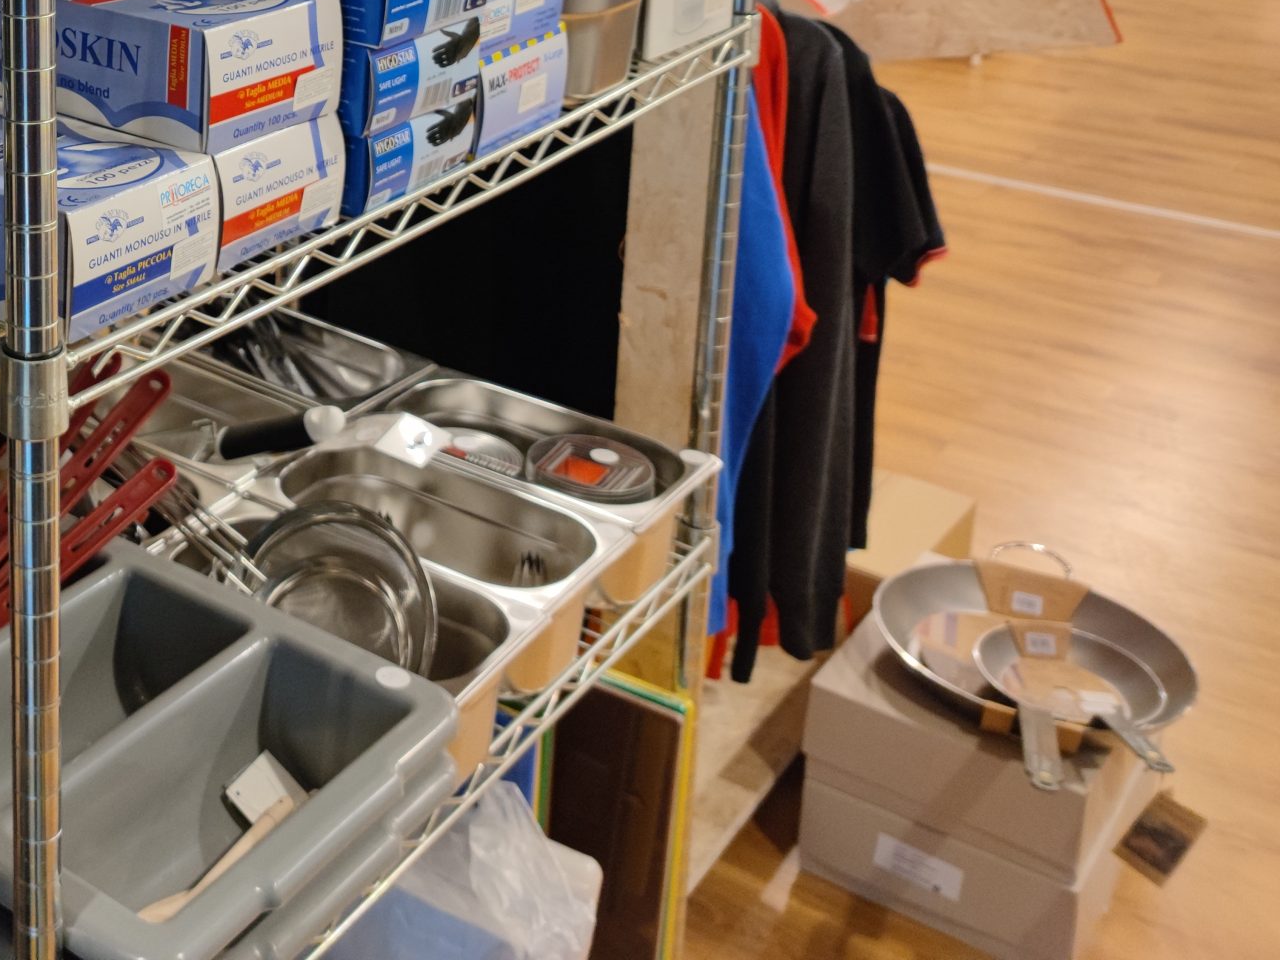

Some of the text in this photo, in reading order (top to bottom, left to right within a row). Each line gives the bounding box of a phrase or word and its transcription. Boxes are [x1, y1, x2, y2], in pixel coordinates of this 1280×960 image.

[223, 68, 253, 83] GUANTI
[256, 53, 297, 72] MONOUSO
[300, 49, 308, 59] IN
[378, 50, 415, 72] HYGOSTAR
[379, 80, 391, 91] SAFE
[489, 57, 541, 92] MAX-PROTECT
[61, 77, 110, 99] no blend
[246, 76, 292, 98] Taglia MEDIA
[257, 91, 284, 105] MEDIUM
[233, 120, 265, 139] Quantity
[268, 115, 281, 125] 100
[375, 131, 410, 155] HYGOSTAR
[86, 158, 155, 185] 100 pezzi
[236, 166, 314, 206] GUANTI MONOUSO IN
[89, 249, 123, 269] GUANTI
[125, 229, 171, 254] MONOUSO
[173, 224, 183, 235] IN
[114, 250, 173, 282] Taglia PICCOLA
[112, 273, 146, 293] Size SMALL
[99, 301, 134, 325] Quantity
[137, 292, 151, 306] 100
